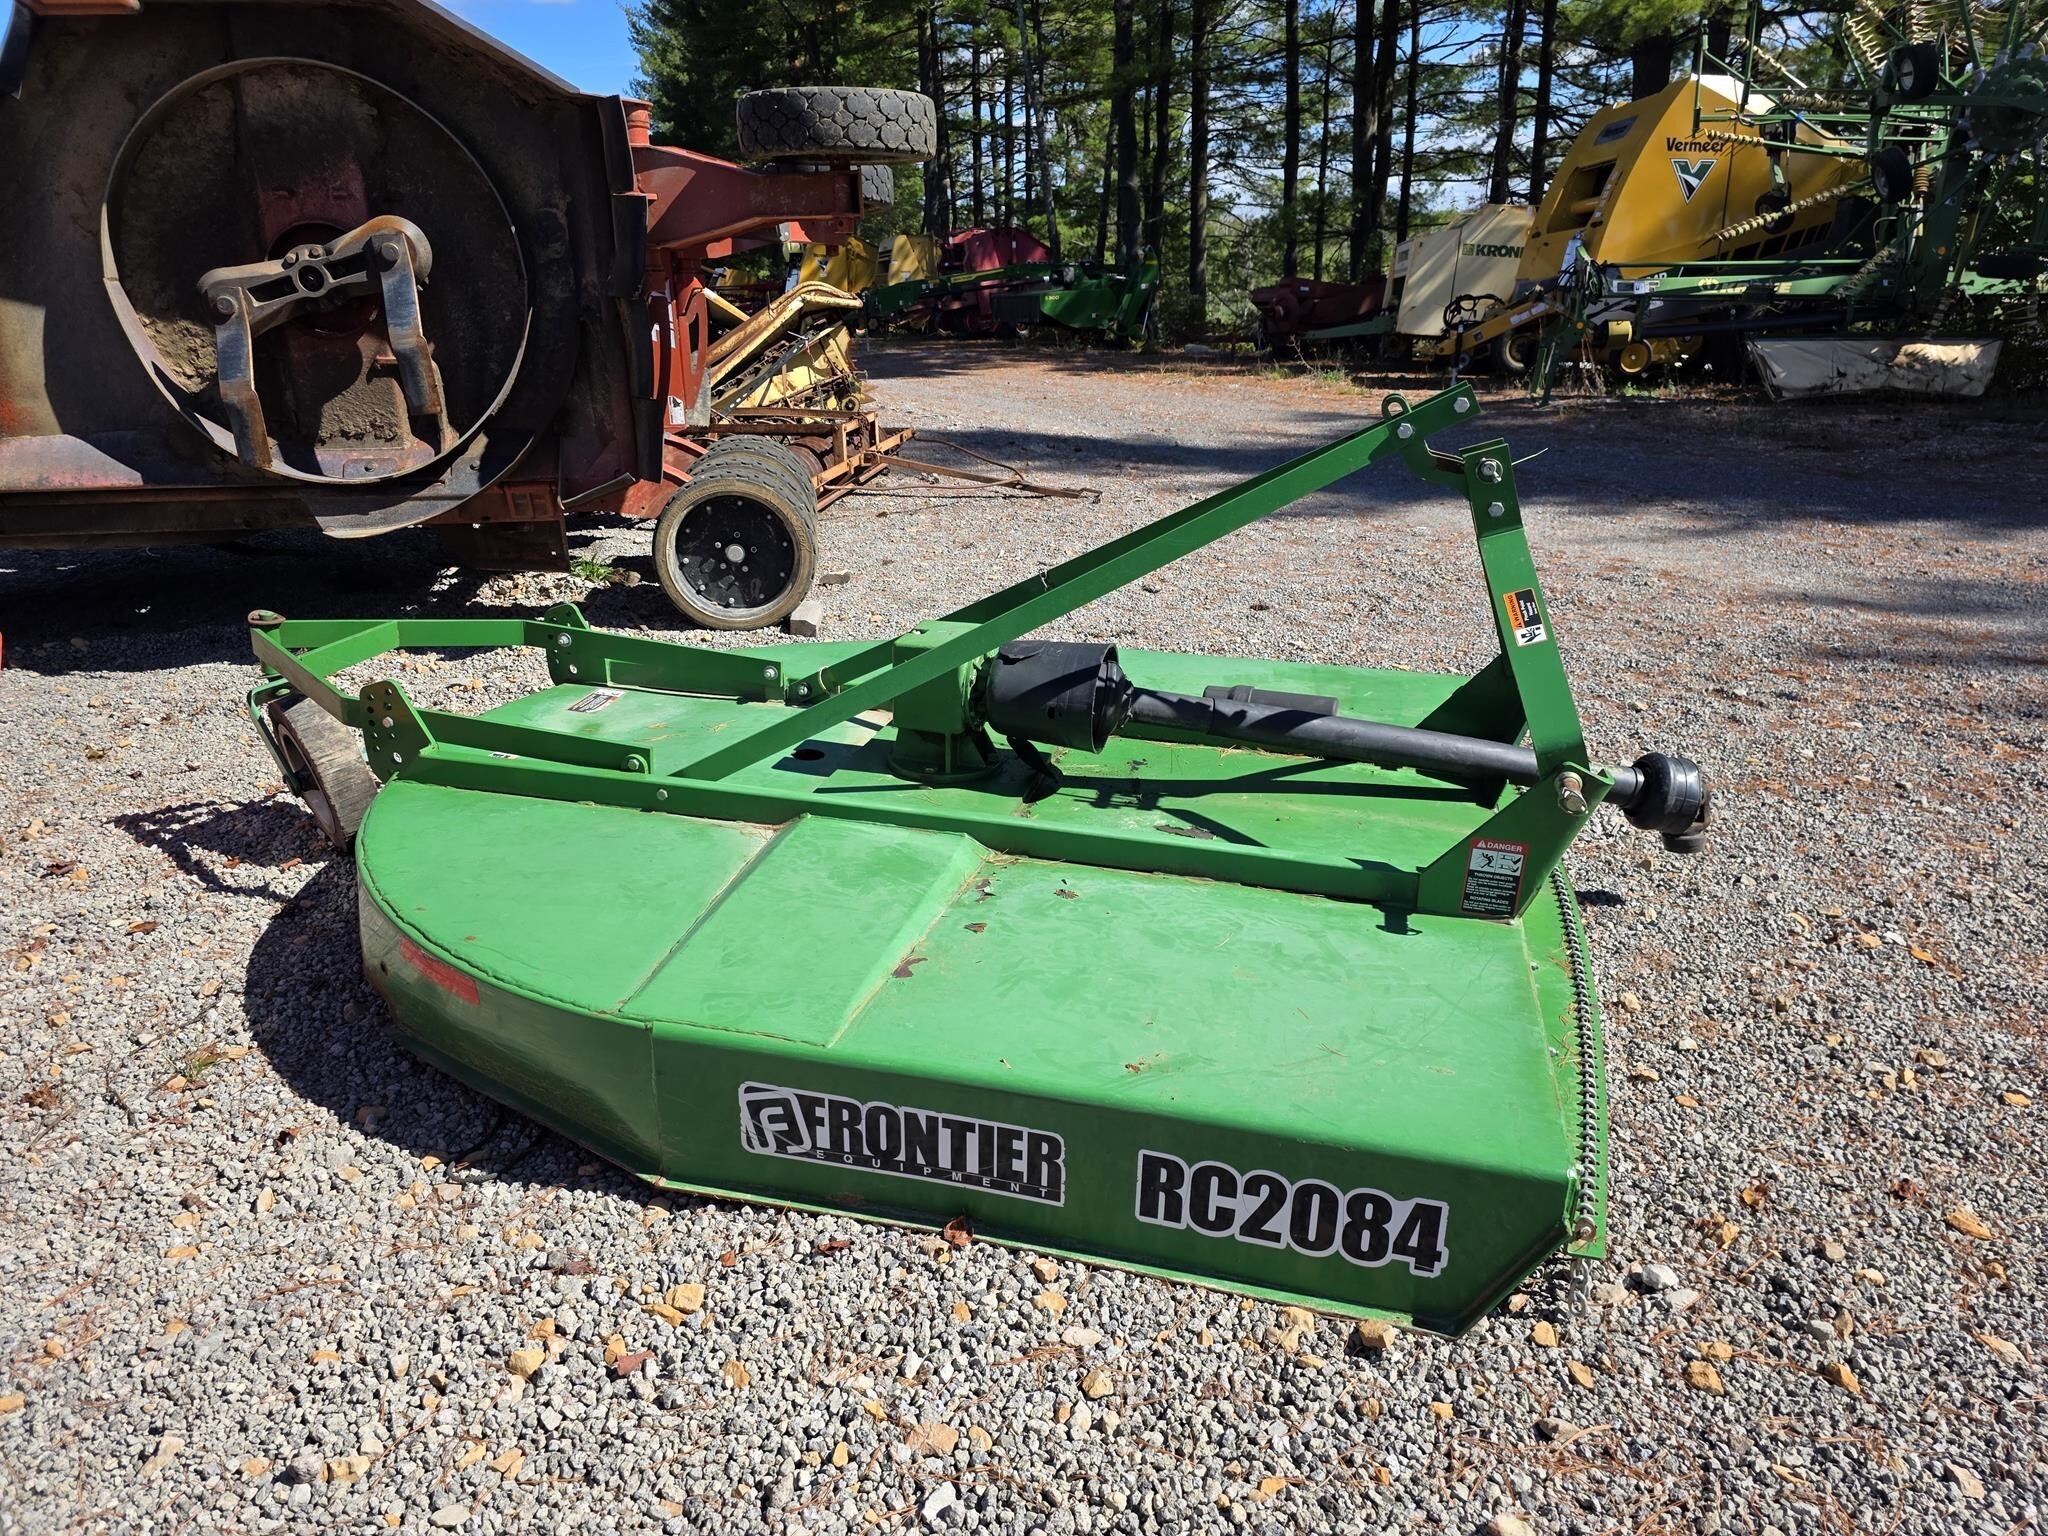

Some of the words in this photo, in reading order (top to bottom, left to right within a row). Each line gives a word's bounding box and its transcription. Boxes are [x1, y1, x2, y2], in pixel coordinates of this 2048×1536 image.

[1666, 137, 1725, 152] Vermeer
[1507, 594, 1520, 623] WARNING
[1487, 841, 1523, 853] DANGER
[793, 1093, 1063, 1189] FRONTIER
[816, 1150, 1048, 1198] EQUIPMENT
[1139, 1153, 1443, 1273] RC2084
